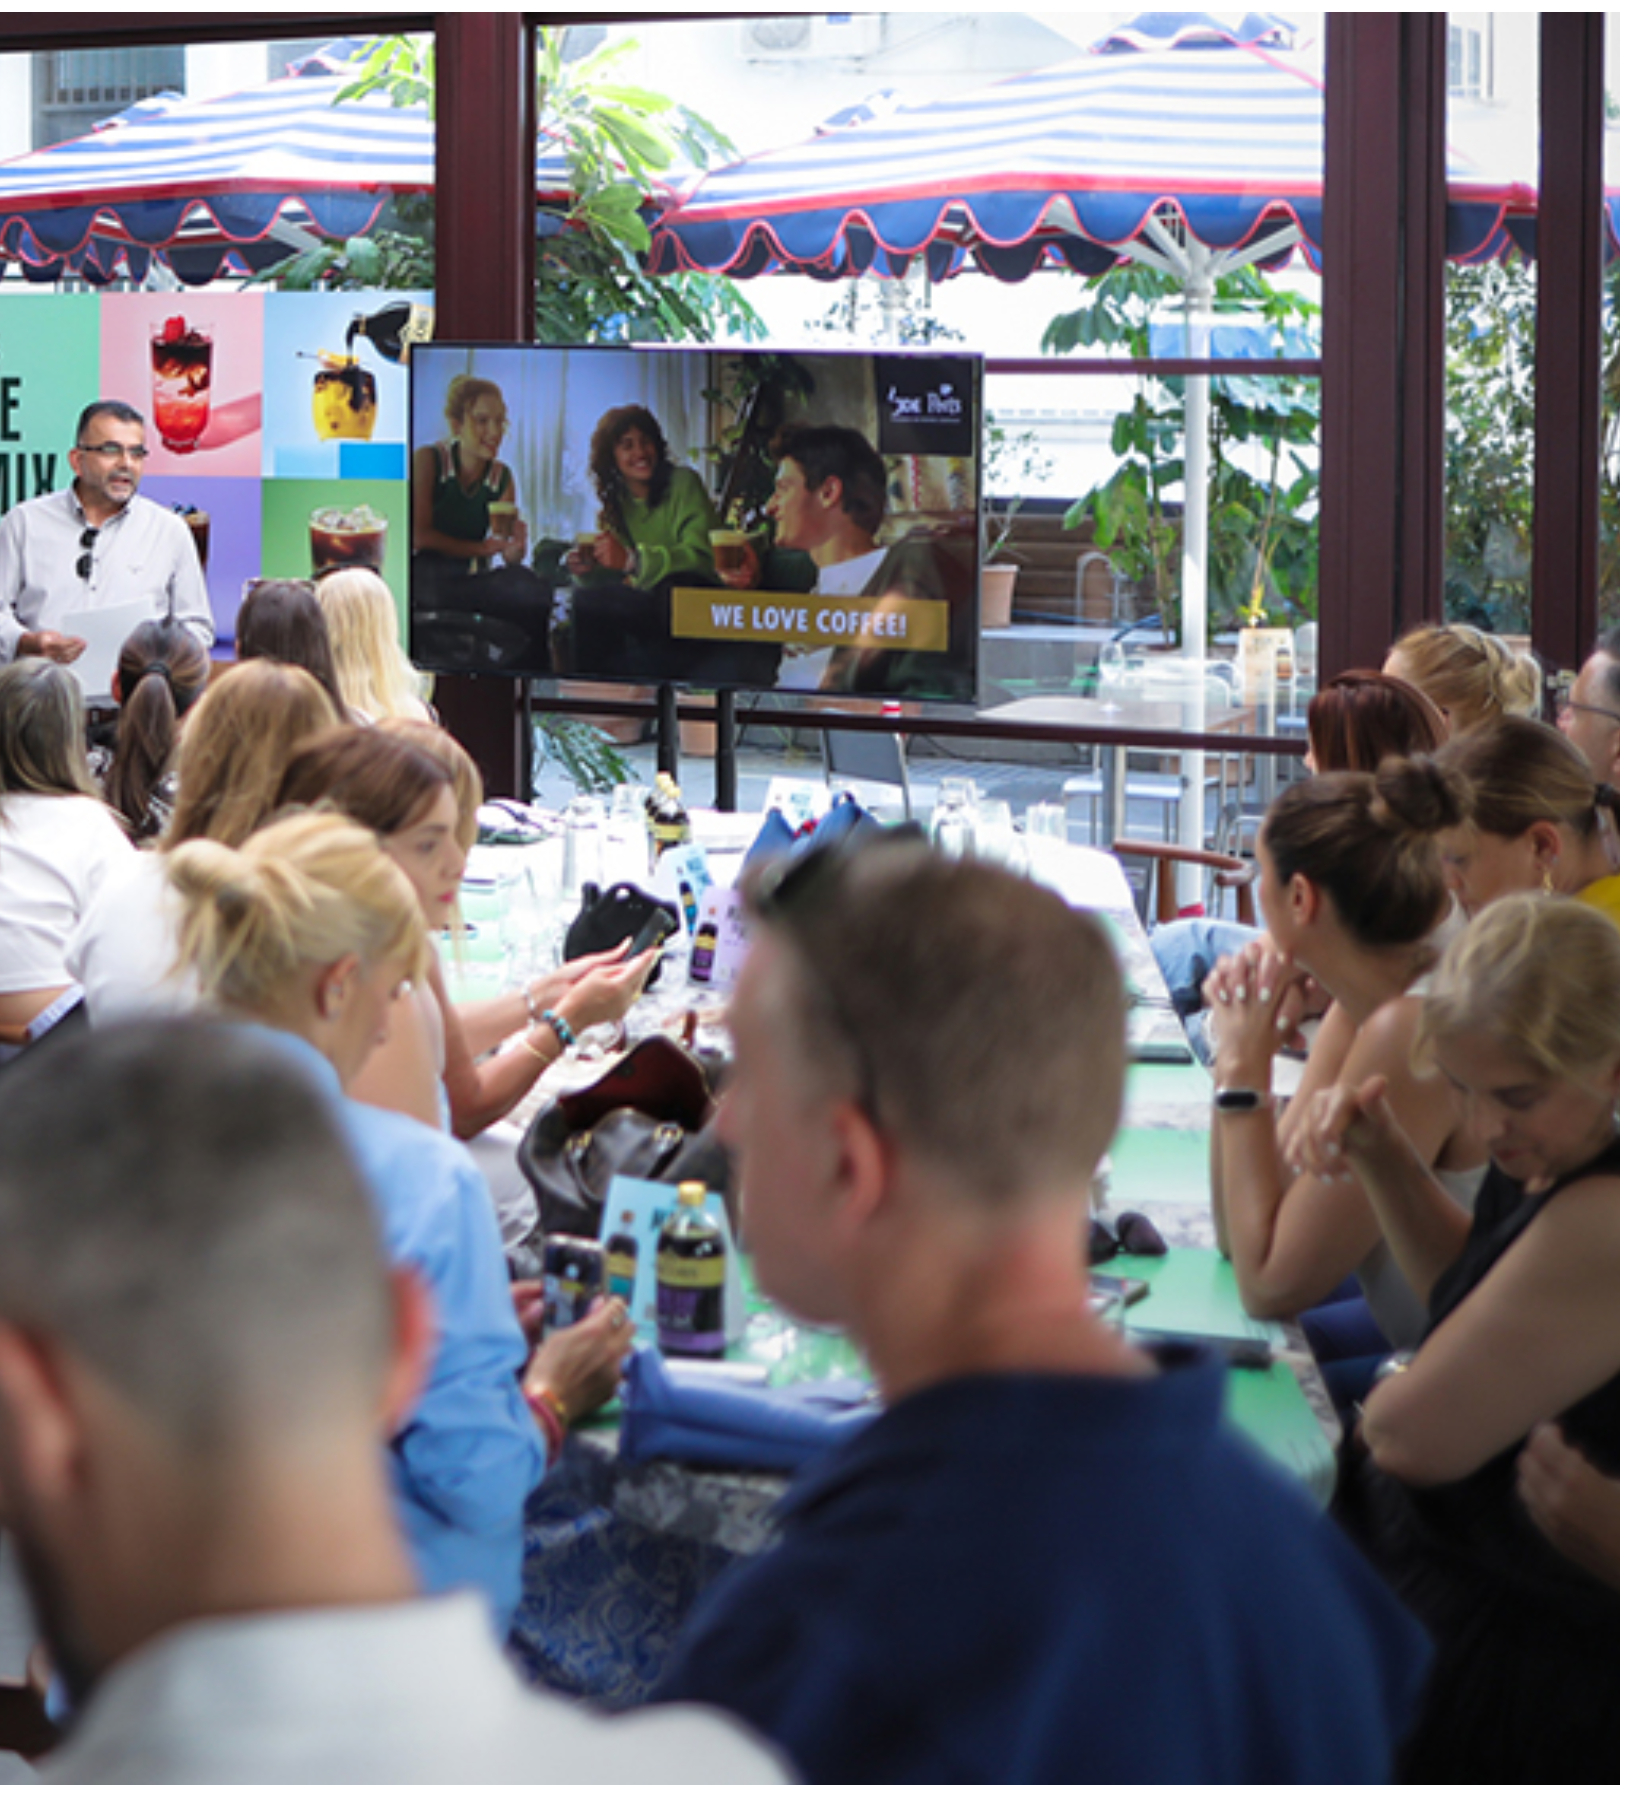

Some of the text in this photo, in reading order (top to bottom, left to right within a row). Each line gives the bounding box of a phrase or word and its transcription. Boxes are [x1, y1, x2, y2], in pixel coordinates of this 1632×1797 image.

[710, 603, 907, 637] WE LOVE COFFEE!
